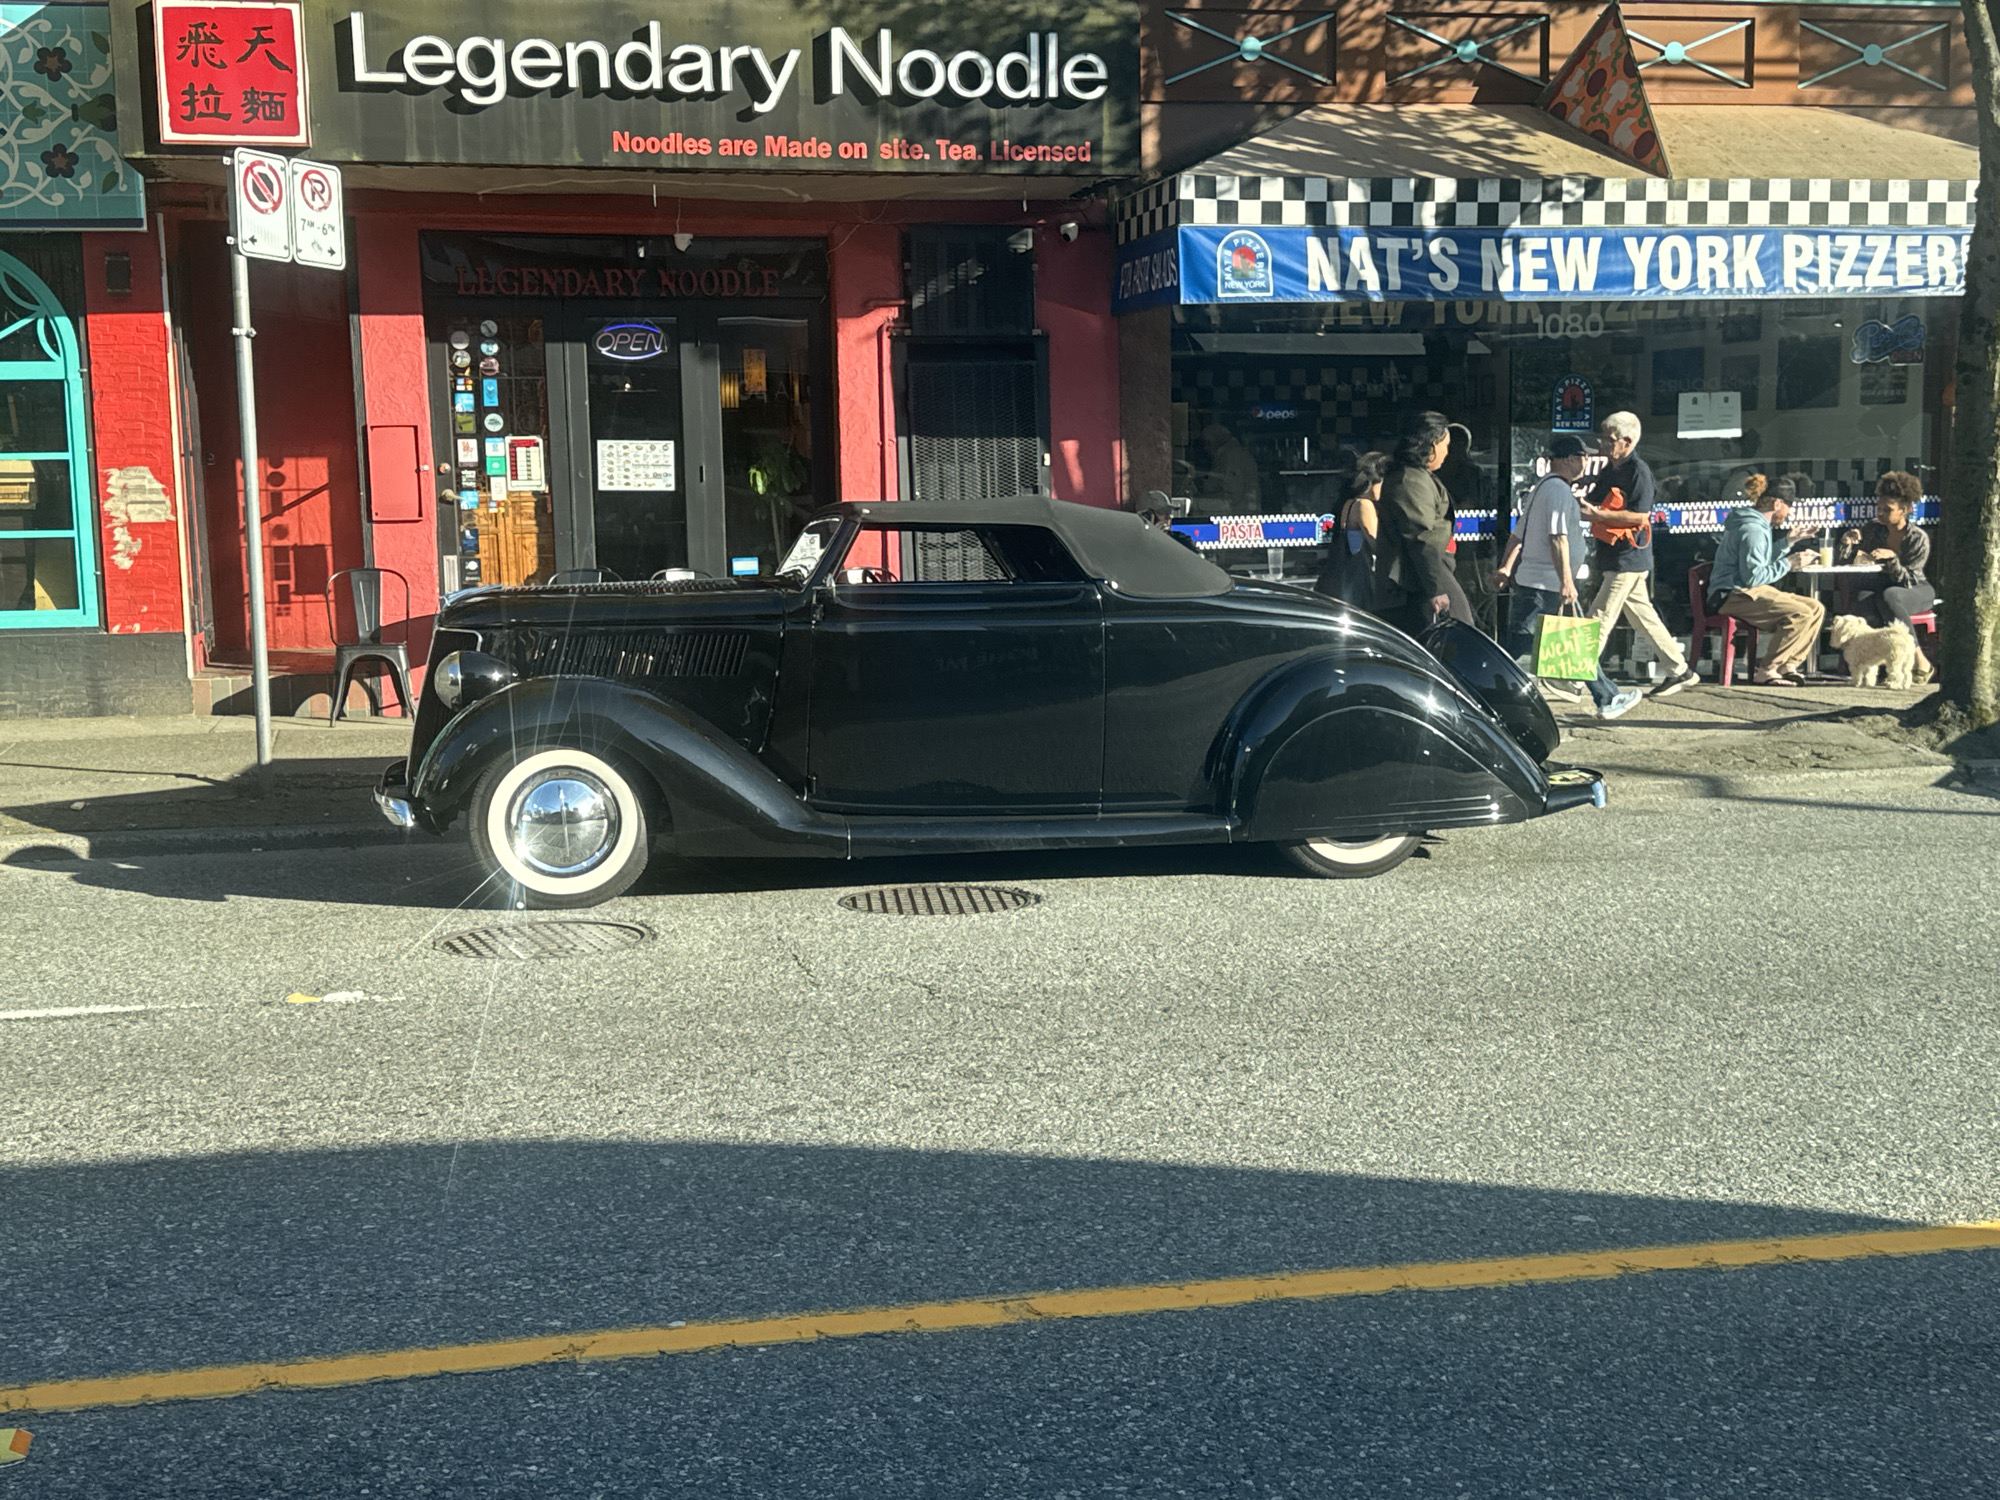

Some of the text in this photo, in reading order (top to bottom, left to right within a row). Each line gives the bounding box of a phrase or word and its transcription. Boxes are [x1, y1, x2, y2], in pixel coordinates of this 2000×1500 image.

[350, 10, 1109, 113] Legendary Noodle
[612, 131, 1092, 163] Noodles are Made on site. Tea. Licensed
[1233, 236, 1266, 280] PIZZERIA
[1306, 236, 1459, 292] NAT'S
[1481, 236, 1602, 292] NEW
[1624, 235, 1766, 291] YORK
[457, 266, 780, 297] LEGENDARY NOODLE
[1224, 280, 1267, 289] NEW YORK
[1536, 313, 1604, 339] 1080
[596, 333, 664, 351] OPEN
[1681, 510, 1718, 525] PIZZA
[1788, 505, 1836, 521] SALADS
[1220, 522, 1264, 540] PASTA
